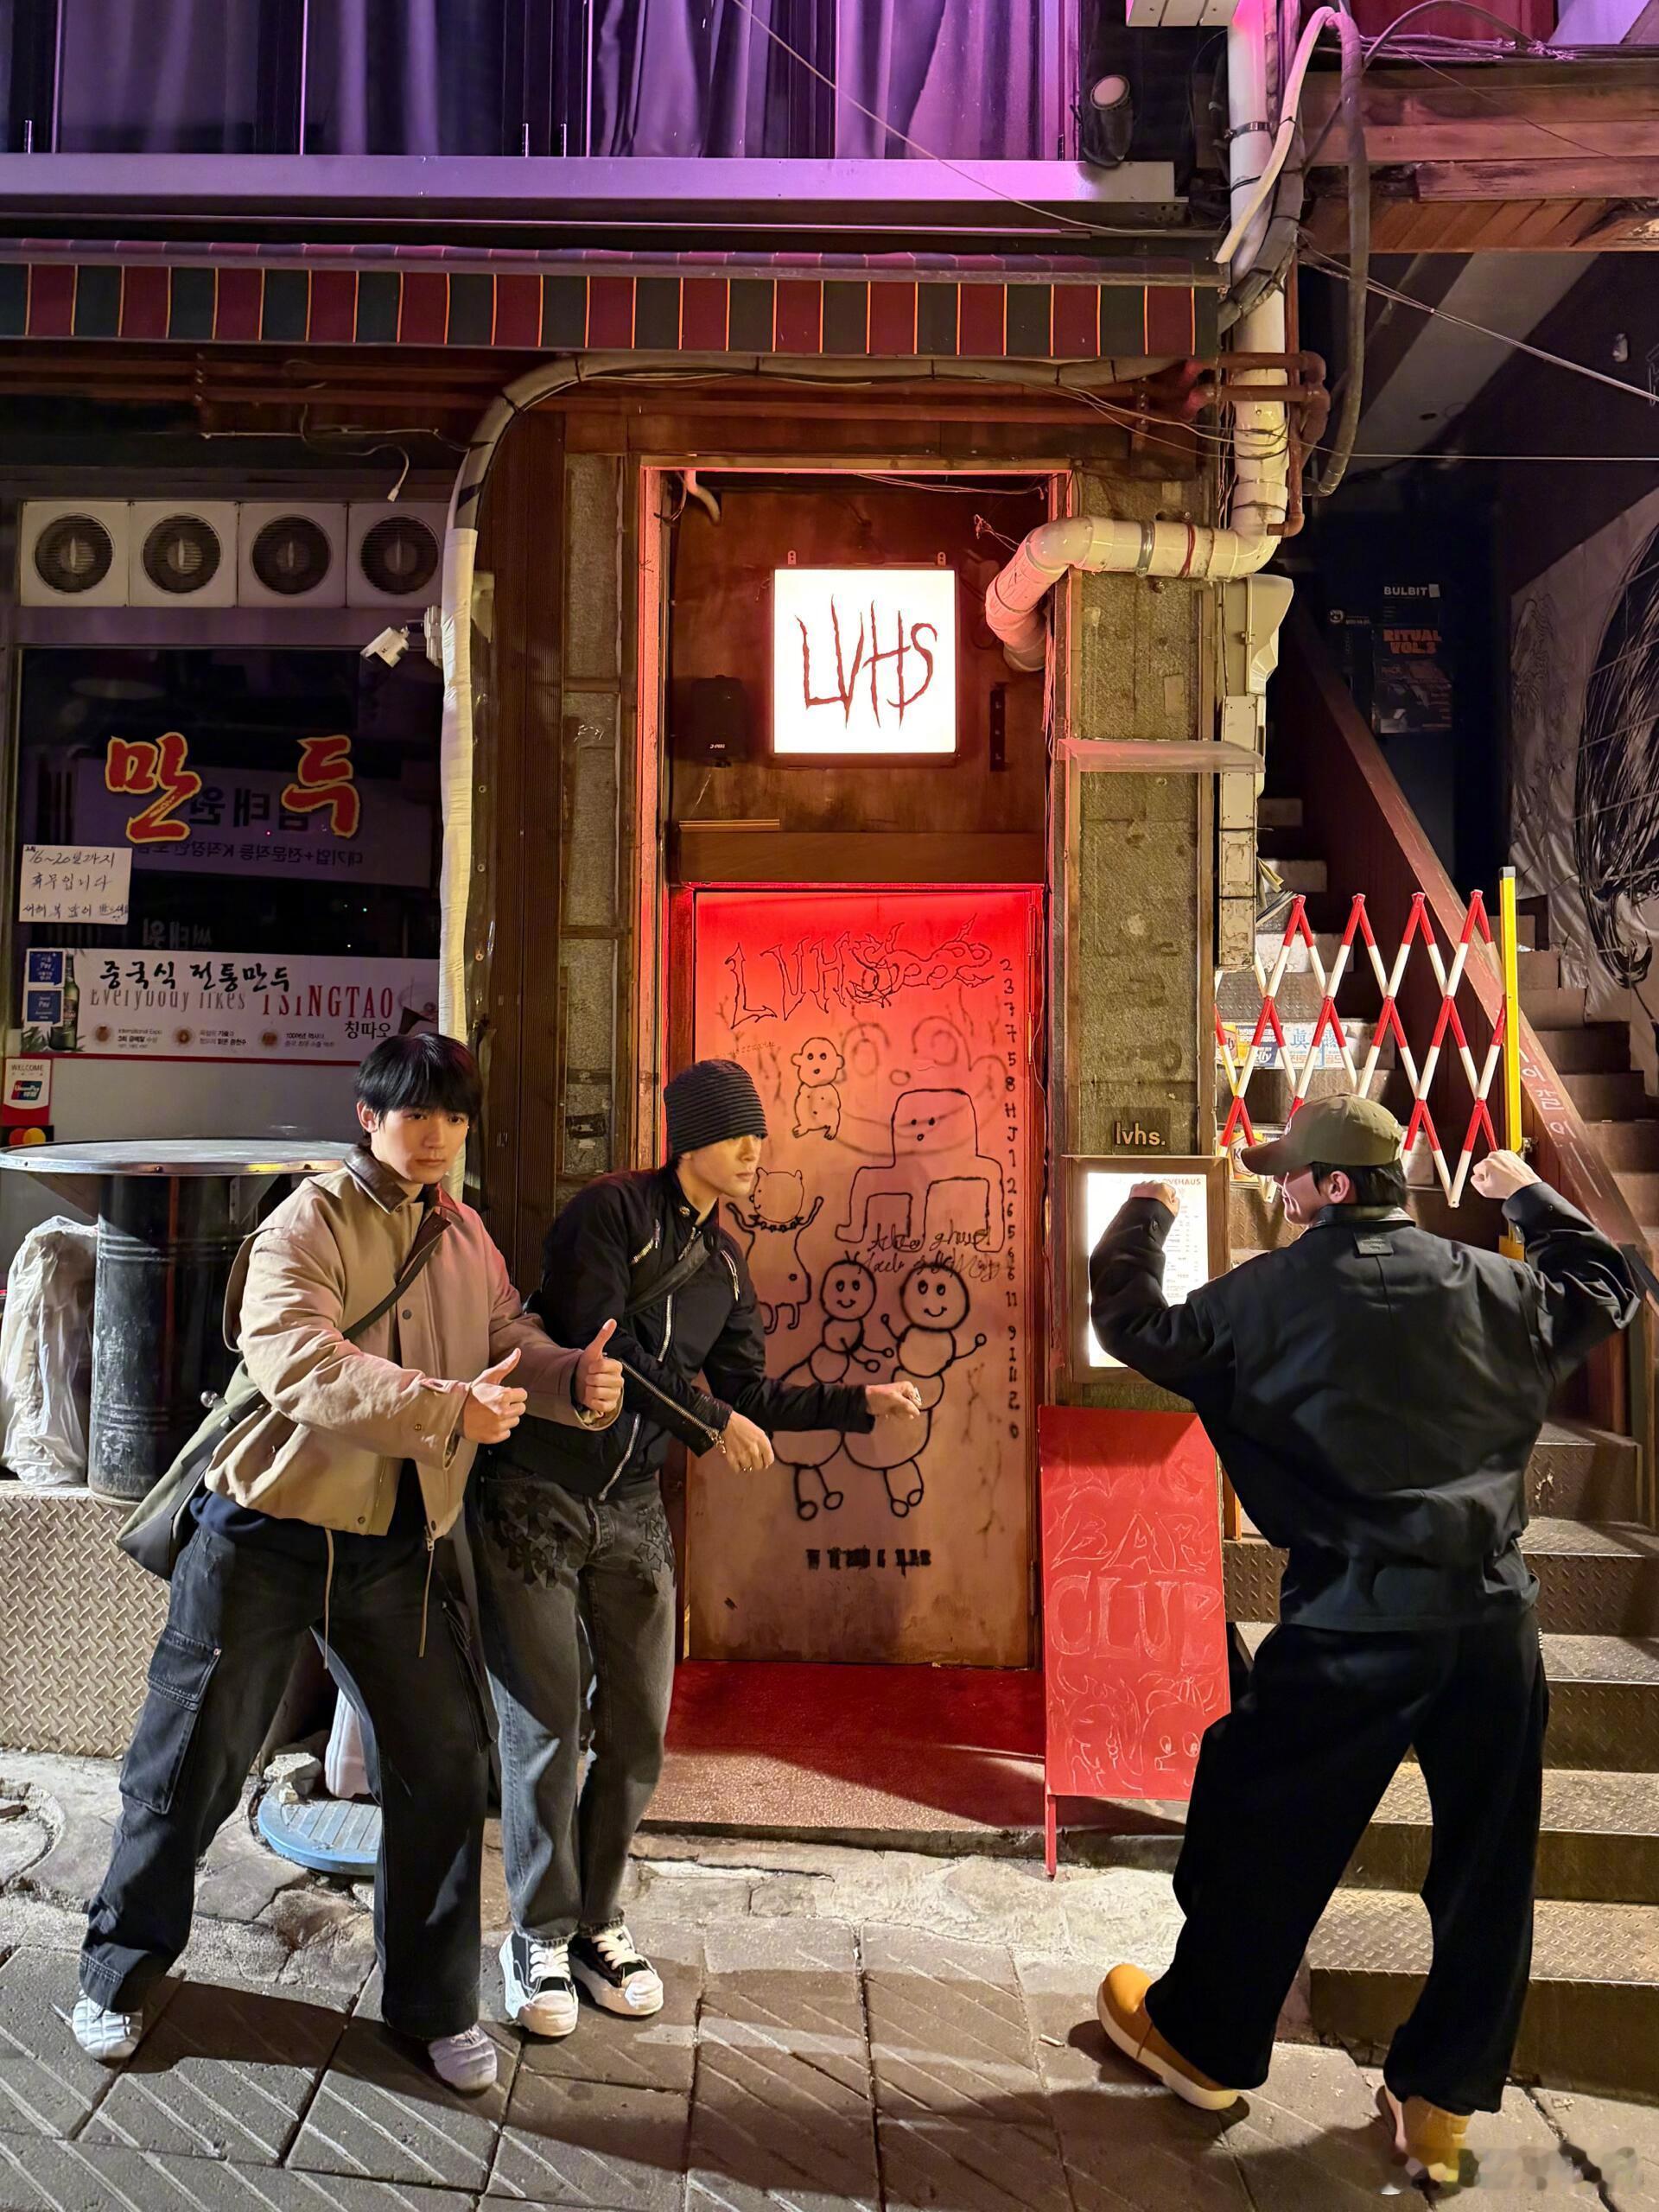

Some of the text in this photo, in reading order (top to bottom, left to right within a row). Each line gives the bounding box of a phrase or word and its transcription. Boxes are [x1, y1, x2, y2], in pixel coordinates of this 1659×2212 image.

[1383, 586, 1428, 596] BULBIT
[1383, 628, 1442, 642] RITUAL
[794, 594, 938, 729] LVHS
[99, 960, 290, 992] 중국식 전통만두
[345, 1021, 391, 1041] 칭따오
[1116, 1121, 1166, 1146] lvhs.
[1161, 1178, 1202, 1186] VEHAUS
